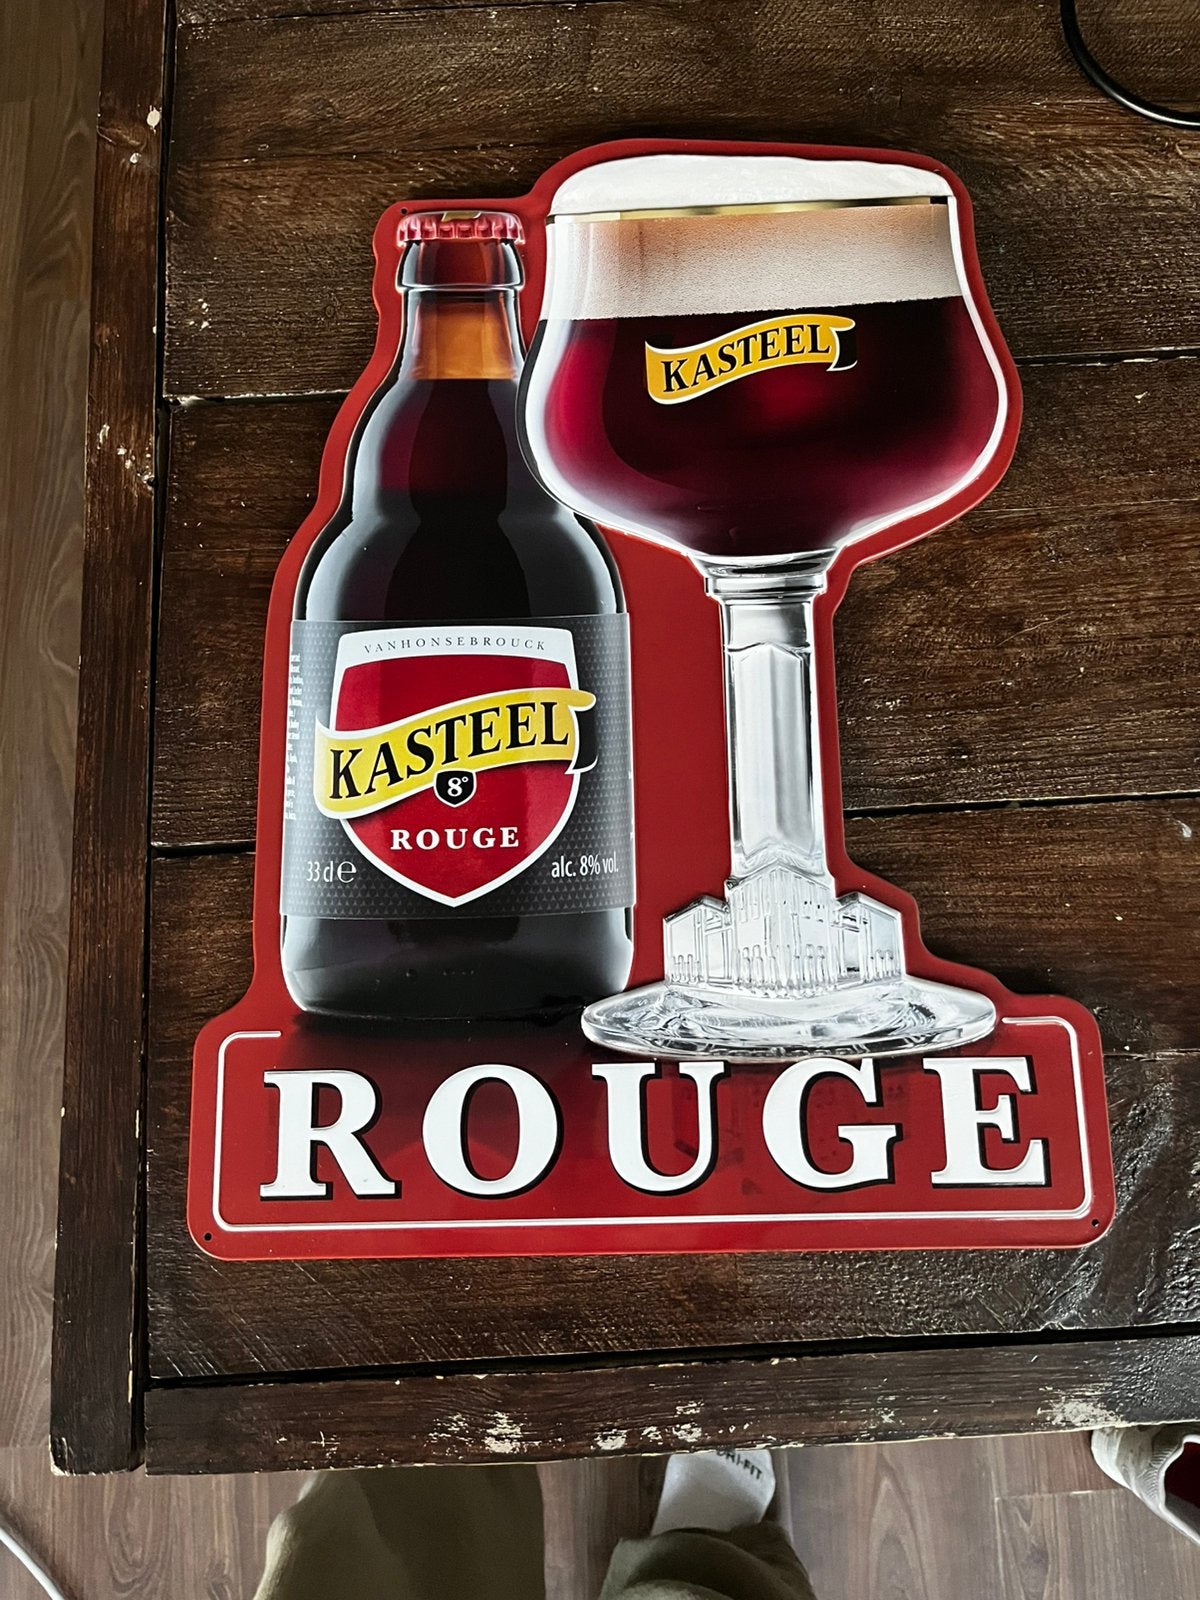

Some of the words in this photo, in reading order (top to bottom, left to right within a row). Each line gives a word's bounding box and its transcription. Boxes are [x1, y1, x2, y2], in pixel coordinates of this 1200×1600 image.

[660, 324, 831, 393] KASTEEL
[363, 636, 545, 654] VANHONSEBROUCK
[328, 701, 569, 800] KASTEEL
[390, 827, 519, 851] ROUGE
[551, 855, 577, 878] alc.
[579, 854, 601, 877] 8%
[601, 851, 619, 874] vol.
[259, 1056, 1050, 1199] ROUGE
